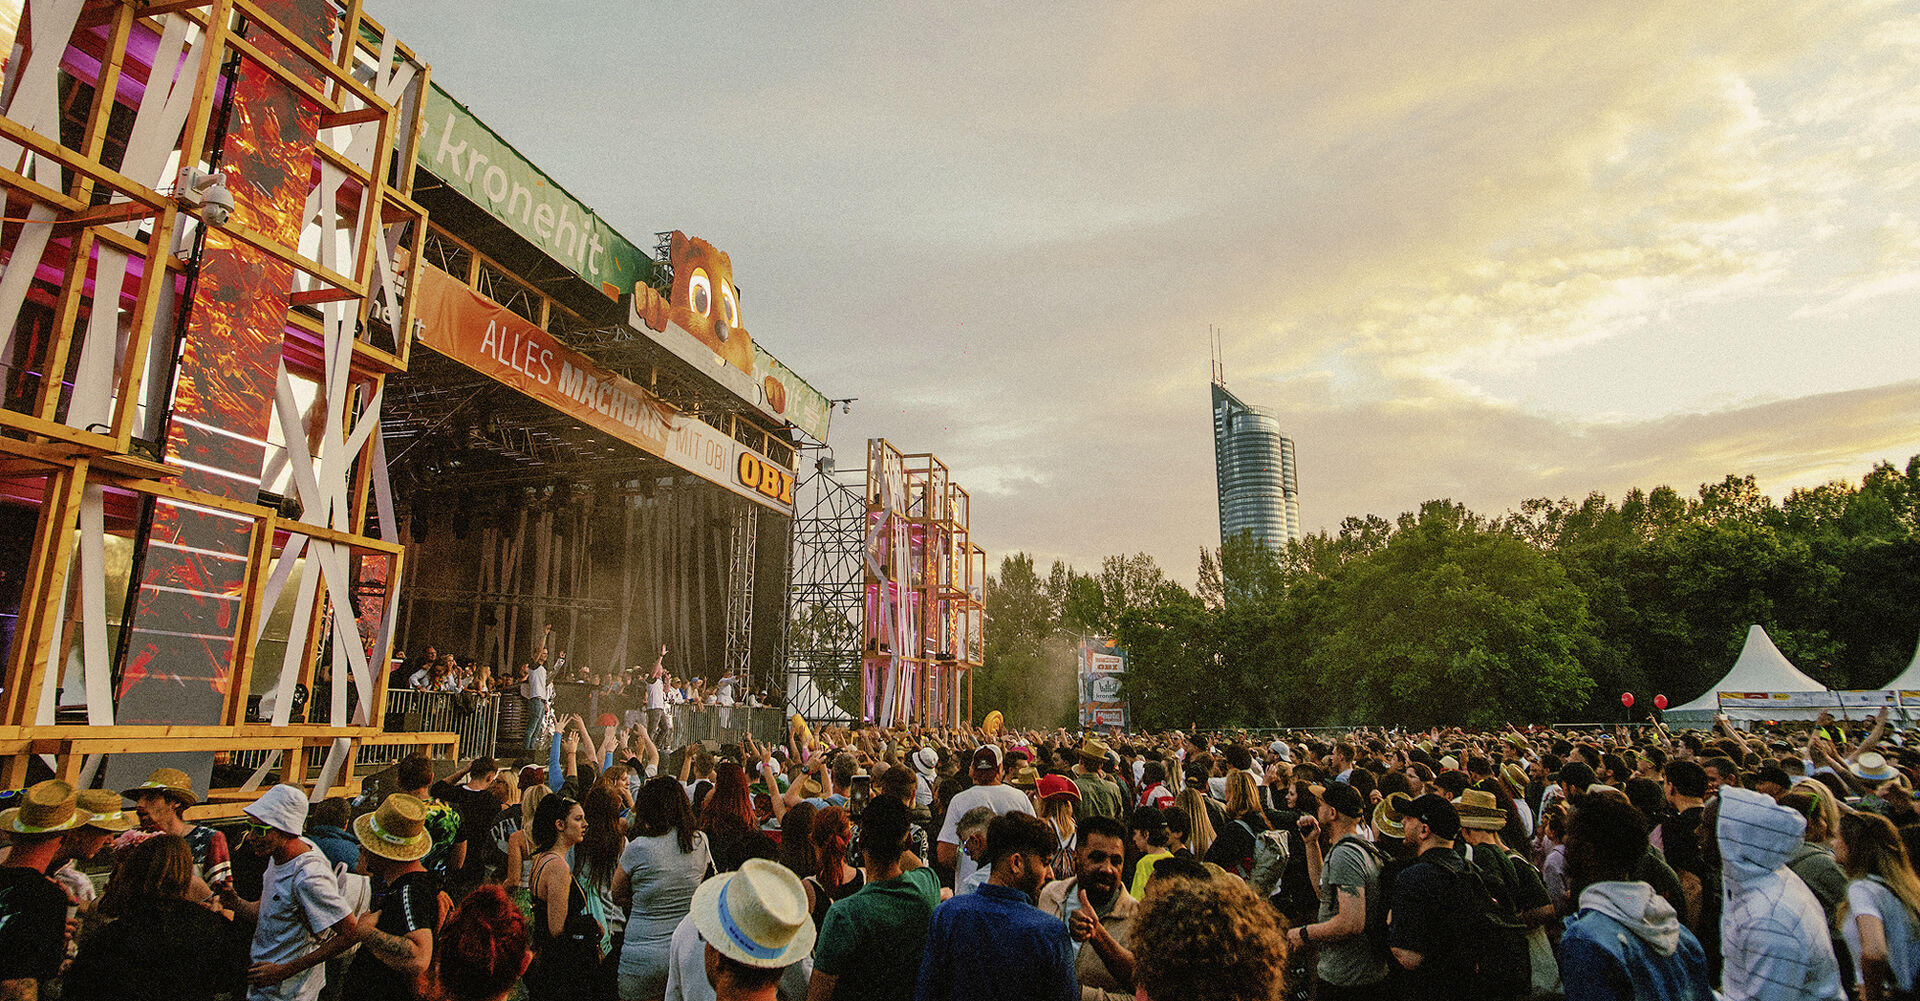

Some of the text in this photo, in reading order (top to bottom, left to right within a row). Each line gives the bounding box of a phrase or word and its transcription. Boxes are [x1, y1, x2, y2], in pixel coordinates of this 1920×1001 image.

[436, 113, 604, 275] kronehit
[480, 319, 553, 385] ALLES
[675, 427, 702, 460] MIT
[705, 439, 727, 473] OBI
[738, 451, 795, 506] OBI
